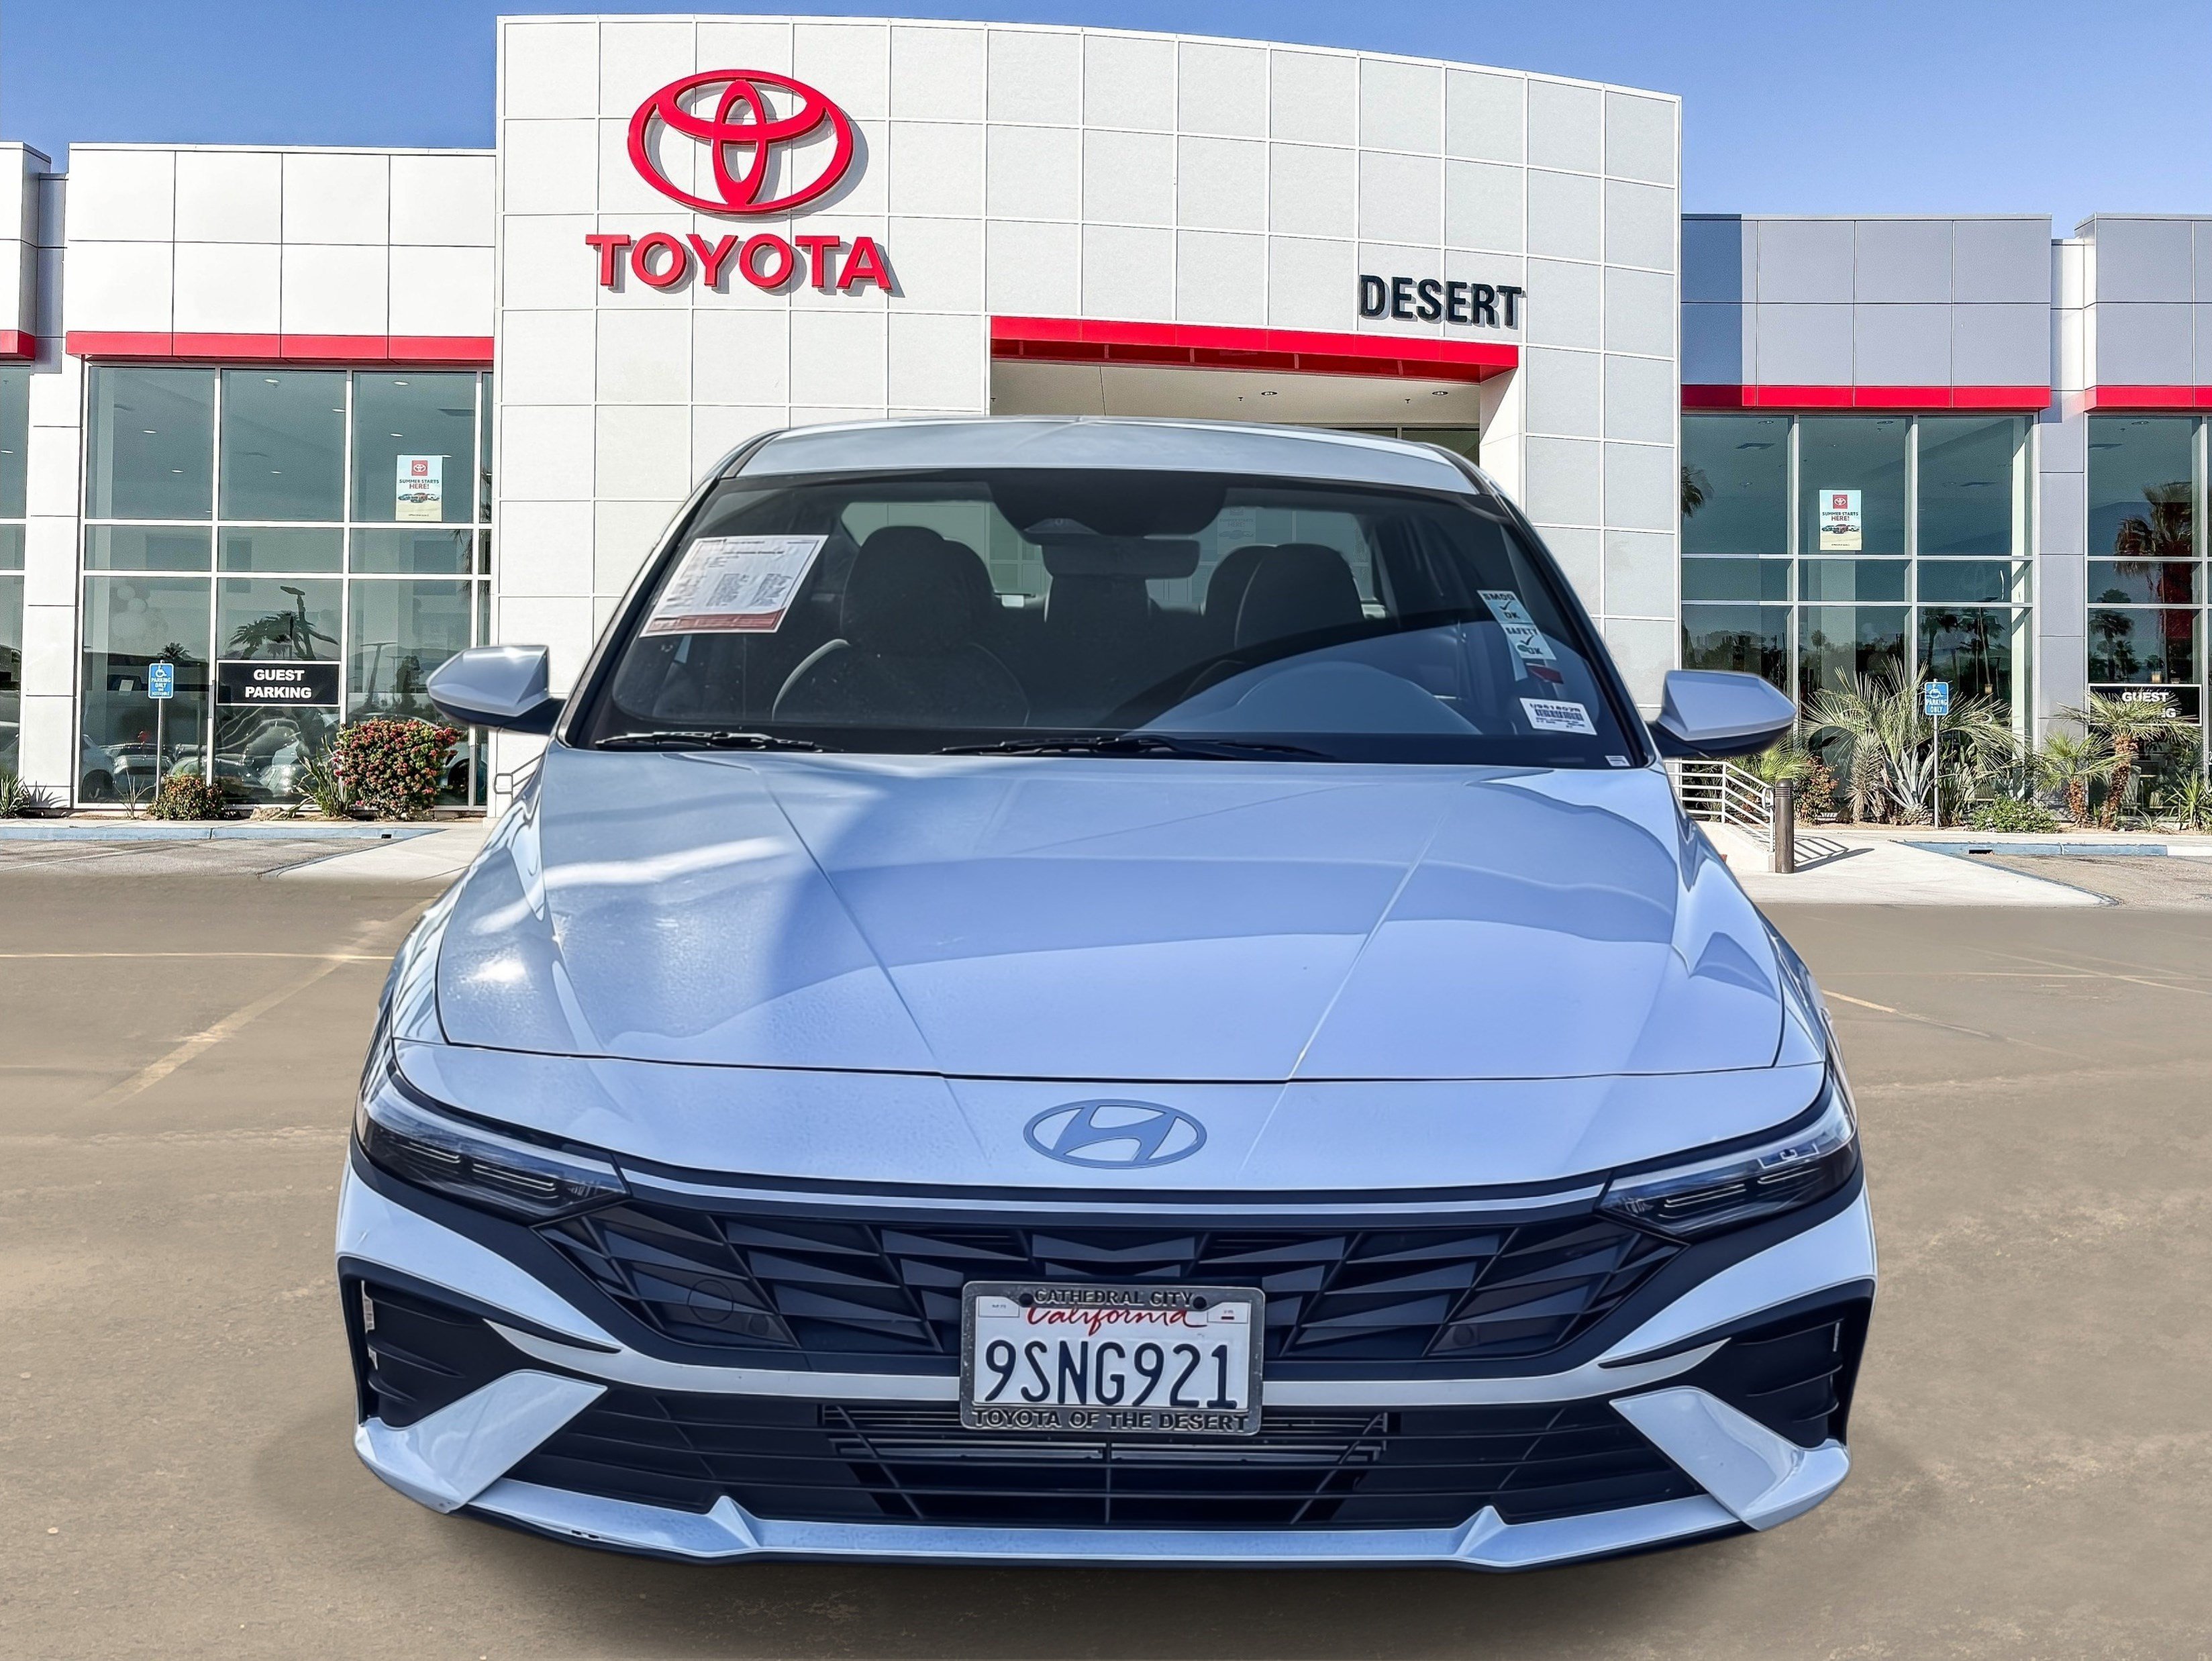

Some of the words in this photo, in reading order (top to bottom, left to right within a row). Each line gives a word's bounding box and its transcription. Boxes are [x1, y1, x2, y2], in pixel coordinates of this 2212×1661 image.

[585, 232, 895, 291] TOYOTA
[1359, 274, 1522, 326] DESERT
[253, 669, 305, 681] GUEST
[245, 686, 311, 699] PARKING
[2121, 692, 2169, 702] GUEST
[1034, 1289, 1144, 1306] CATHEDRAL
[1150, 1291, 1193, 1307] CITY
[985, 1340, 1238, 1409] 9SNG921
[972, 1409, 1061, 1428] TOYOTA
[1068, 1411, 1098, 1429] OF
[1107, 1412, 1152, 1430] THE
[1158, 1413, 1249, 1432] DESERT
